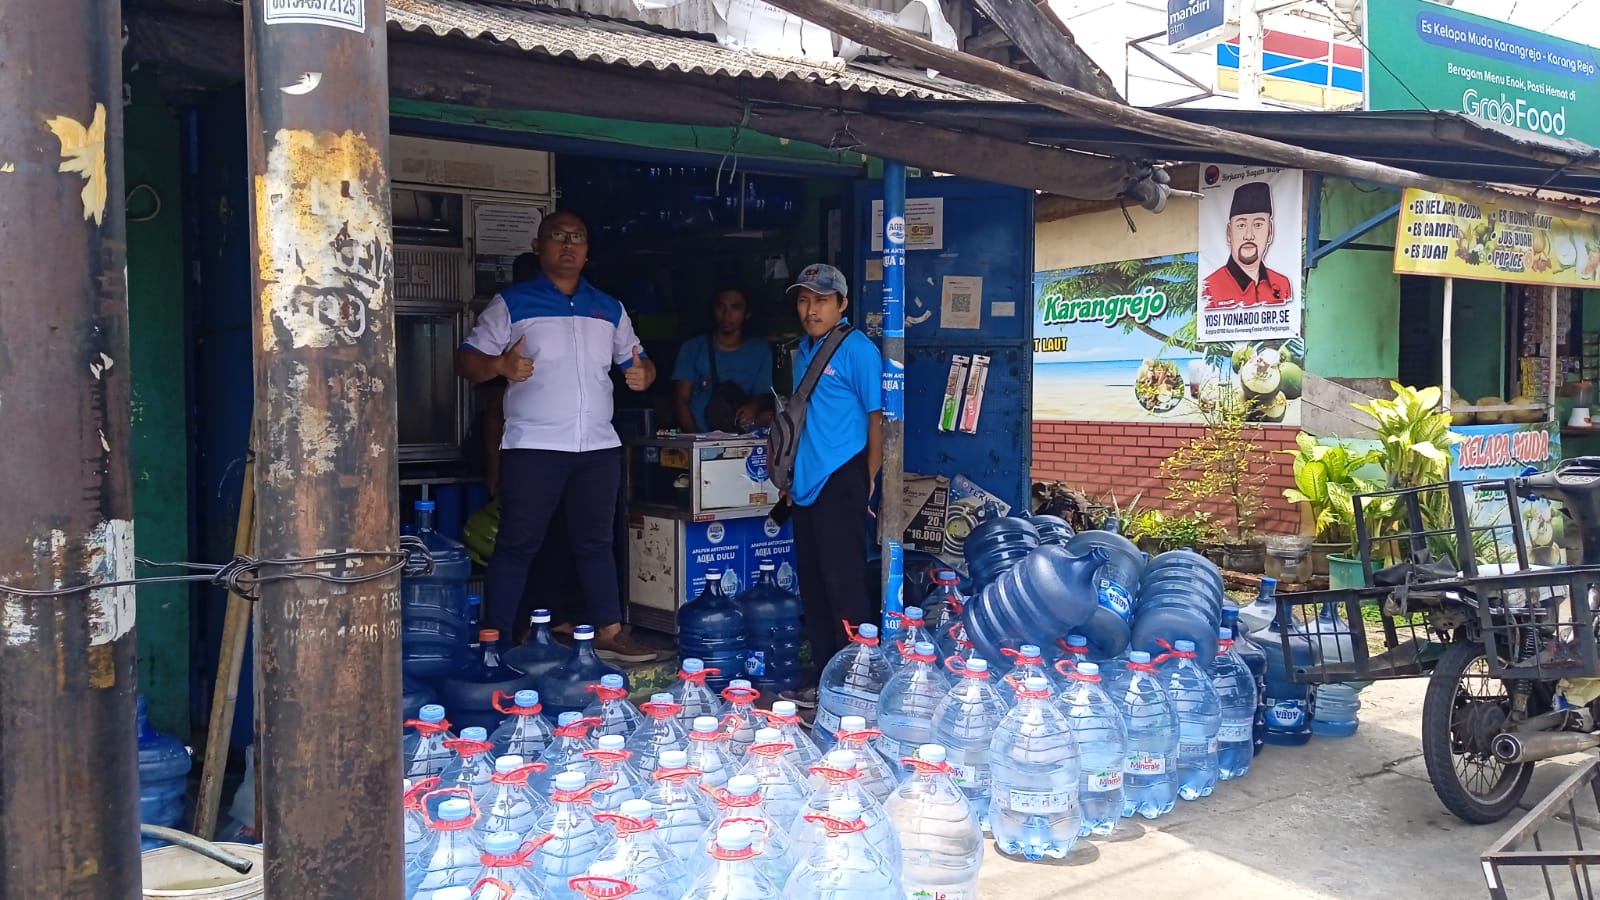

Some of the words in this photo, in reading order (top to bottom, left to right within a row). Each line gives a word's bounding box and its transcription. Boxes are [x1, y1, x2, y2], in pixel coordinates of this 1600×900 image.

[1169, 0, 1210, 25] mandiri
[1170, 22, 1185, 35] atm
[1421, 19, 1432, 34] Es
[1433, 23, 1466, 43] Kelapa
[1468, 31, 1493, 48] Muda
[1494, 38, 1542, 63] Karangrejo
[1547, 52, 1576, 72] Karang
[1577, 60, 1594, 76] Rejo
[1447, 62, 1483, 81] Beragam
[1484, 70, 1505, 84] Menu
[1506, 77, 1527, 92] Enak,
[1527, 80, 1545, 94] Pasti
[1545, 85, 1569, 99] Hemat
[1569, 90, 1577, 101] di
[1462, 88, 1566, 136] GrabFood
[1415, 200, 1424, 214] ES
[1425, 199, 1456, 217] KELAPA
[1457, 202, 1482, 220] MUDA
[1499, 209, 1508, 223] ES
[1413, 222, 1422, 236] ES
[1499, 231, 1514, 245] JUS
[1514, 232, 1533, 247] BUAH
[1411, 244, 1420, 258] ES
[1421, 244, 1448, 260] BUAH
[1043, 286, 1167, 327] Karangrejo
[1205, 314, 1221, 327] YOSI
[1223, 311, 1259, 326] YONARDO
[1279, 309, 1290, 323] SE
[1042, 337, 1068, 352] LAUT
[1459, 434, 1511, 470] KELAPA
[1513, 430, 1549, 464] MUDA
[697, 553, 715, 563] AQUA
[717, 552, 735, 560] DULU
[754, 548, 771, 557] AQUA
[1109, 592, 1127, 610] AQUA
[1275, 709, 1298, 721] AQUA
[1130, 761, 1160, 770] Minerale
